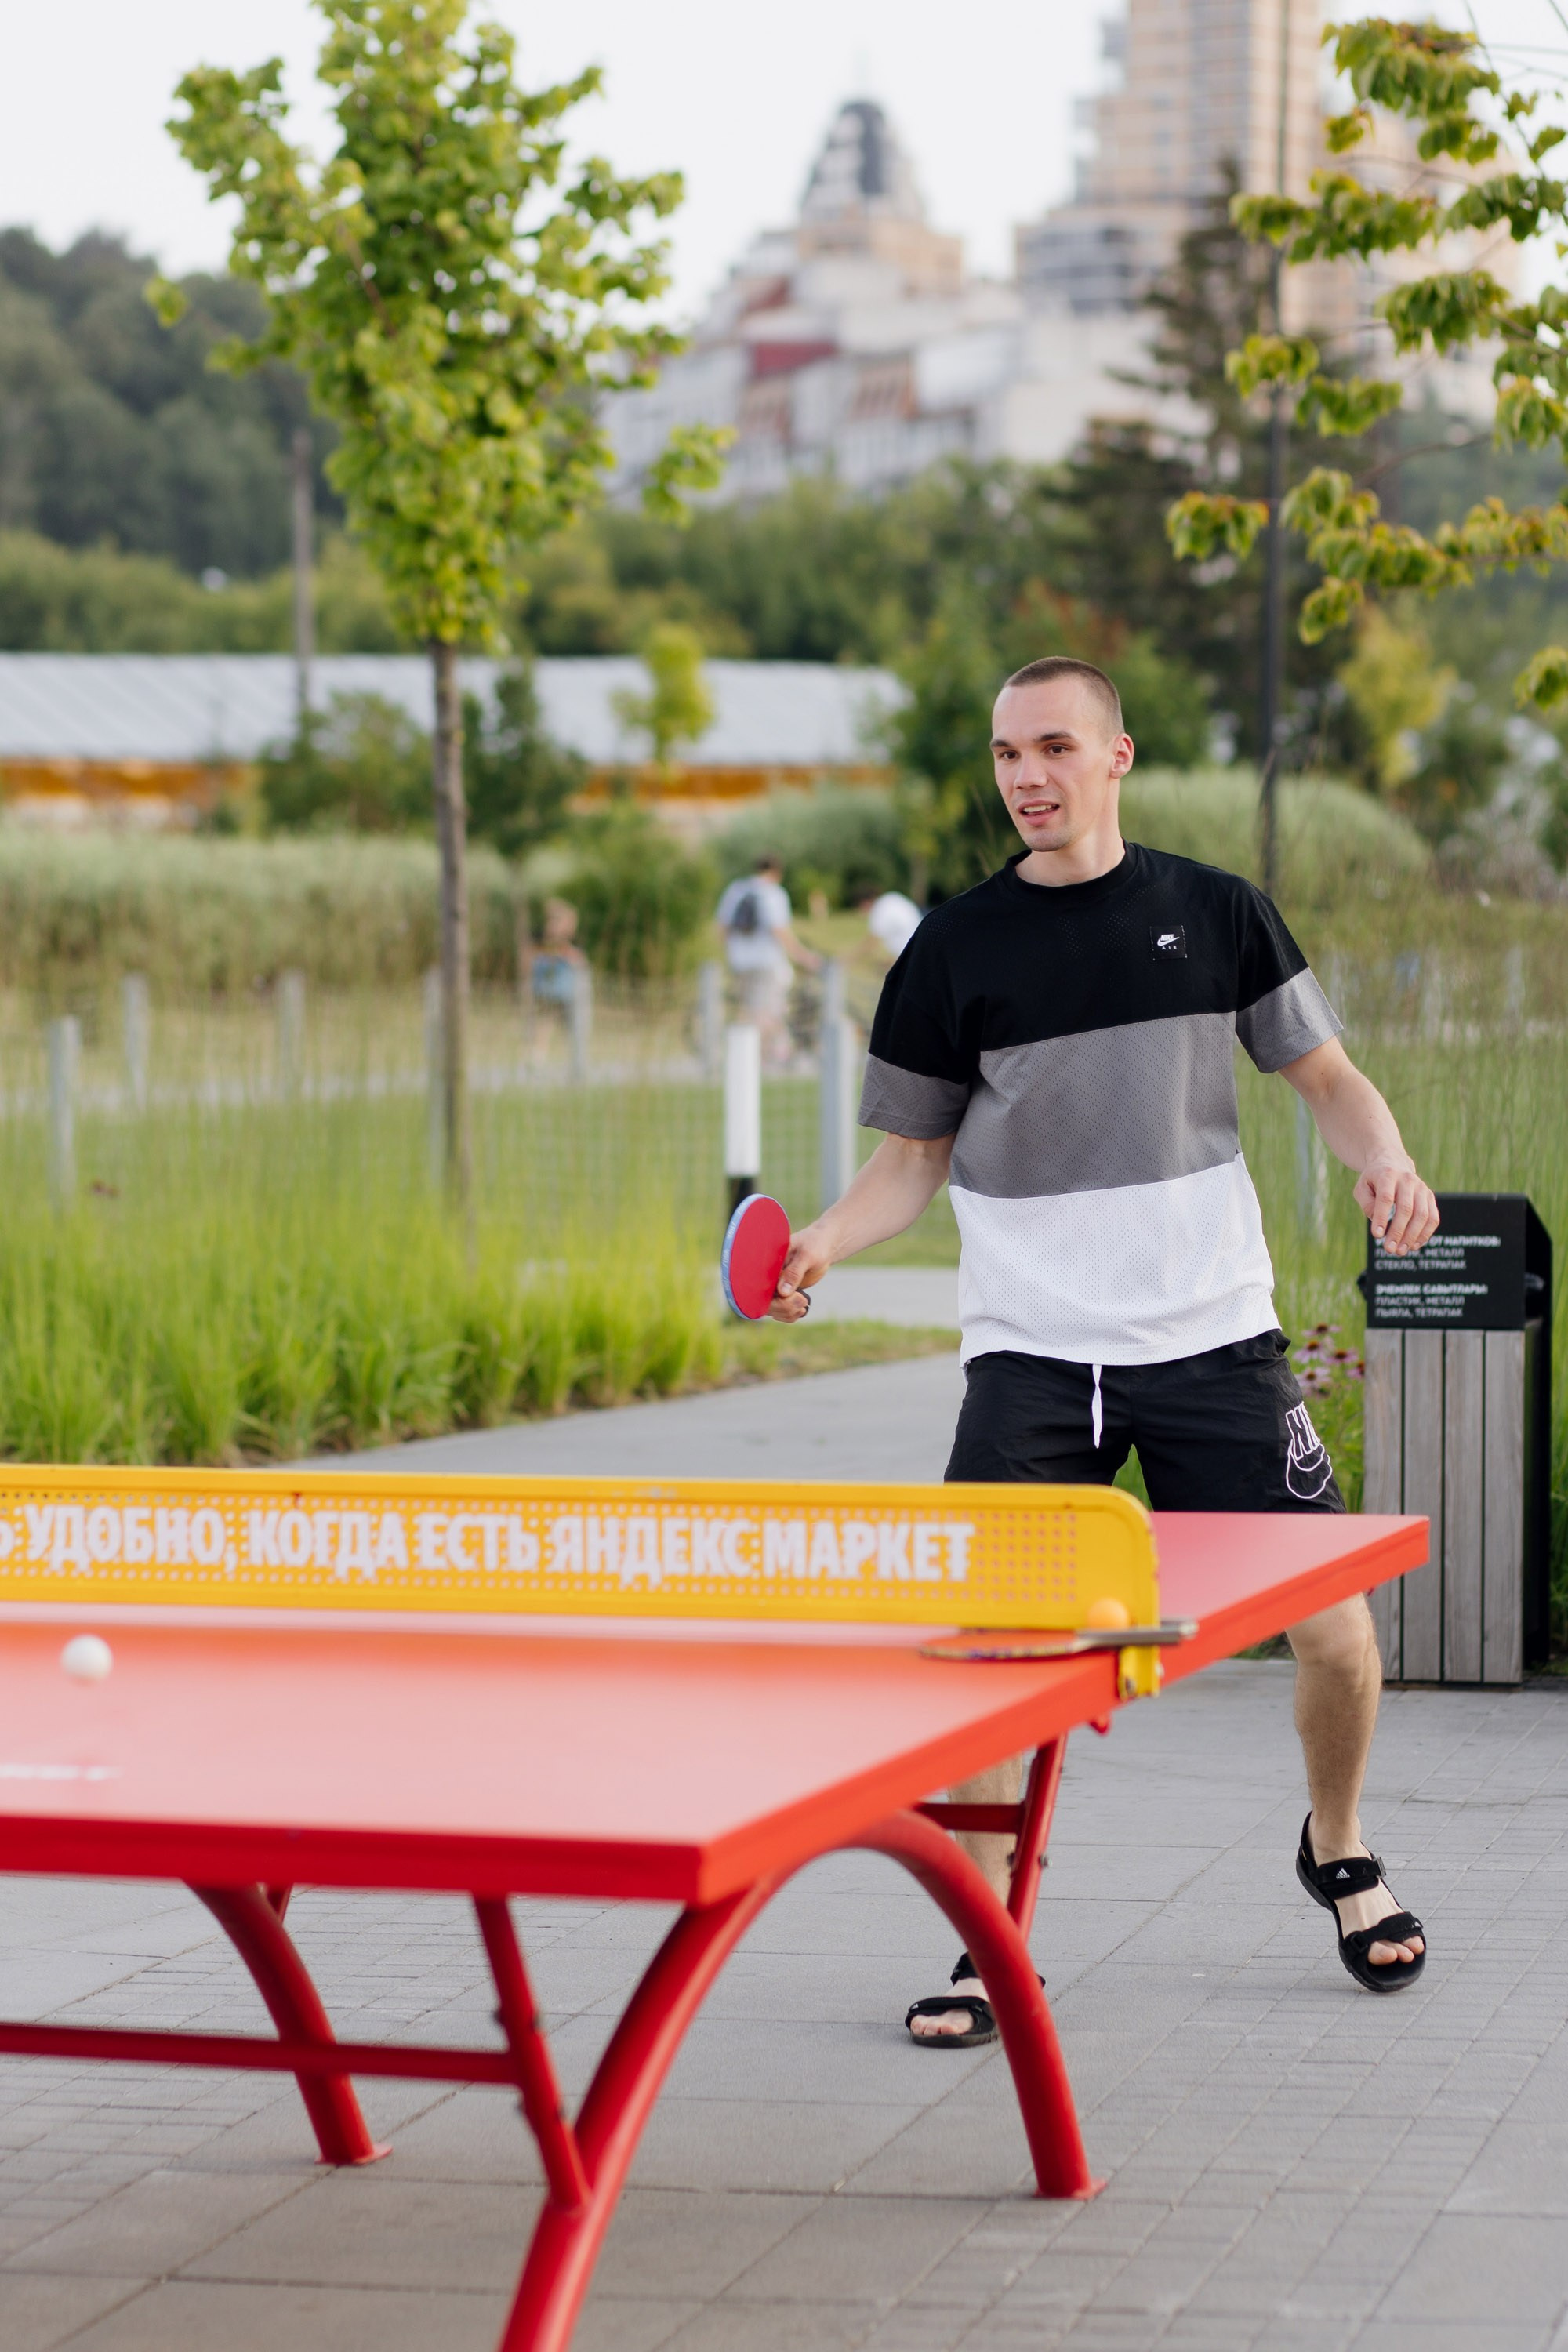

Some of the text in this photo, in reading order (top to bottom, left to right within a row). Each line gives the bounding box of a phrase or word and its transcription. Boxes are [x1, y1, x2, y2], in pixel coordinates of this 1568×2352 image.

[24, 1504, 237, 1573] УДОБНО,
[246, 1509, 410, 1578] КОГДА
[419, 1512, 541, 1571] ЕСТЬ
[550, 1515, 756, 1587] ЯНДЕКС
[763, 1519, 976, 1582] МАРКЕТ
